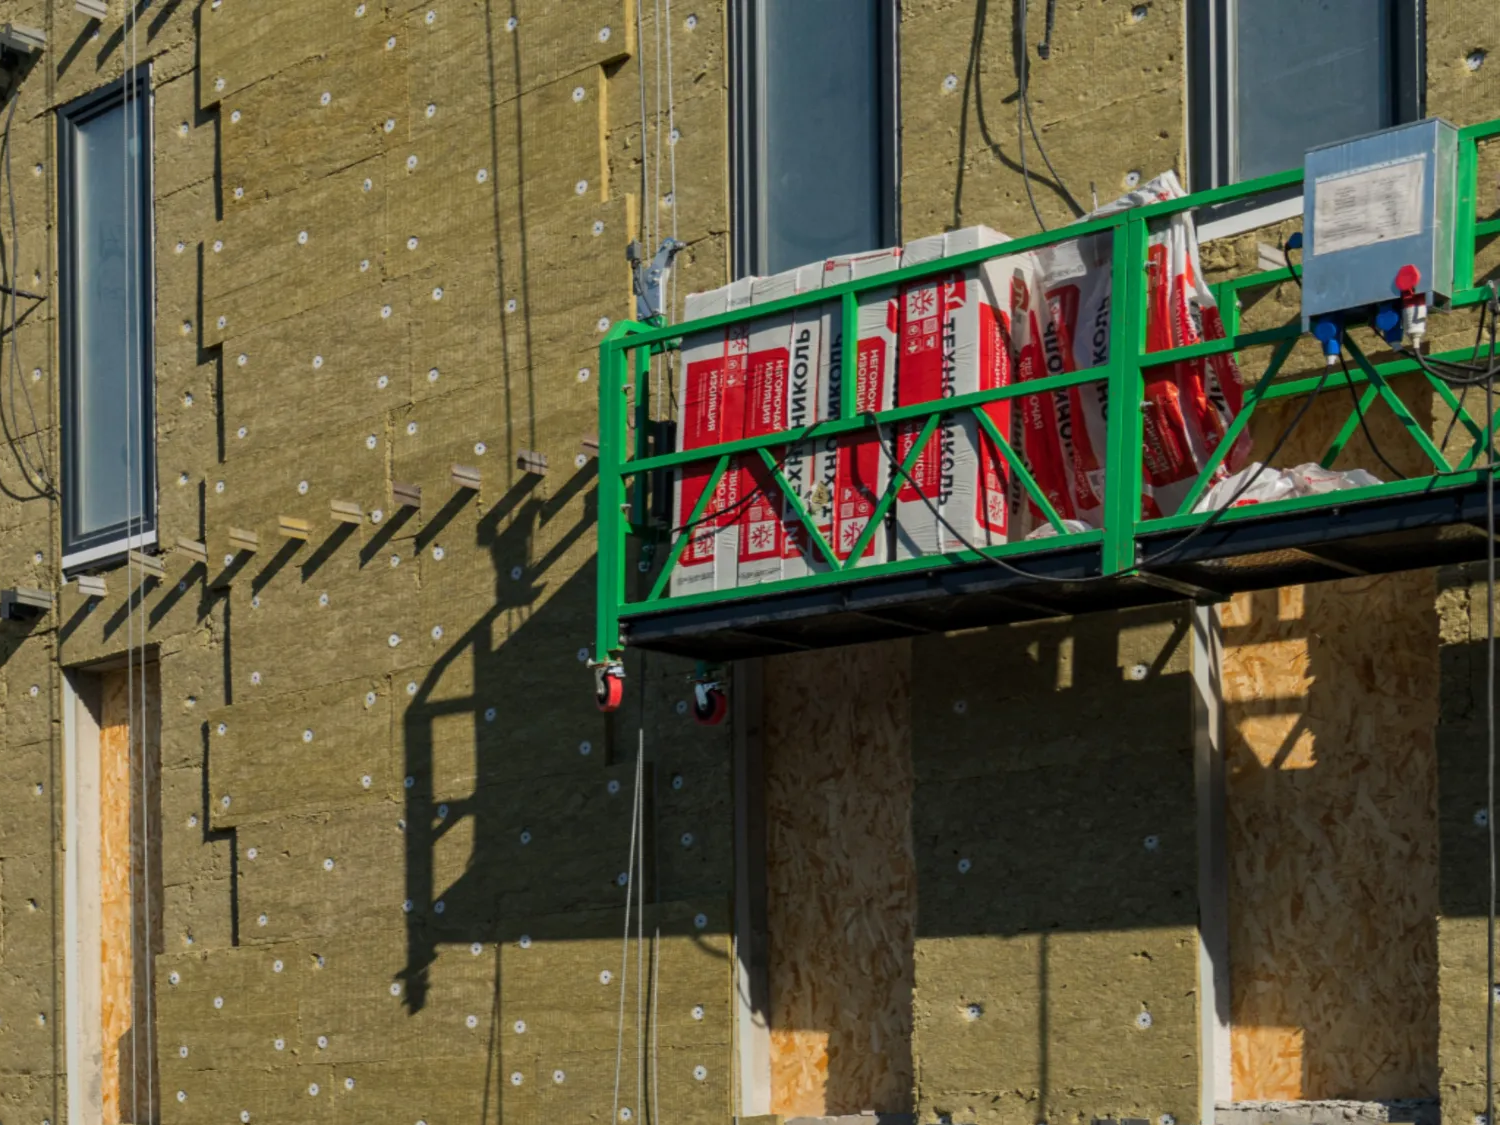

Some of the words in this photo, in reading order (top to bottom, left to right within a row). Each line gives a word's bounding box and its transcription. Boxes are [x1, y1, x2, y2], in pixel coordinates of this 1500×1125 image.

[707, 370, 718, 432] ИЗОЛЯЦИЯ
[762, 361, 774, 425] ИЗОЛЯЦИЯ
[856, 351, 867, 413] ИЗОЛЯЦИ
